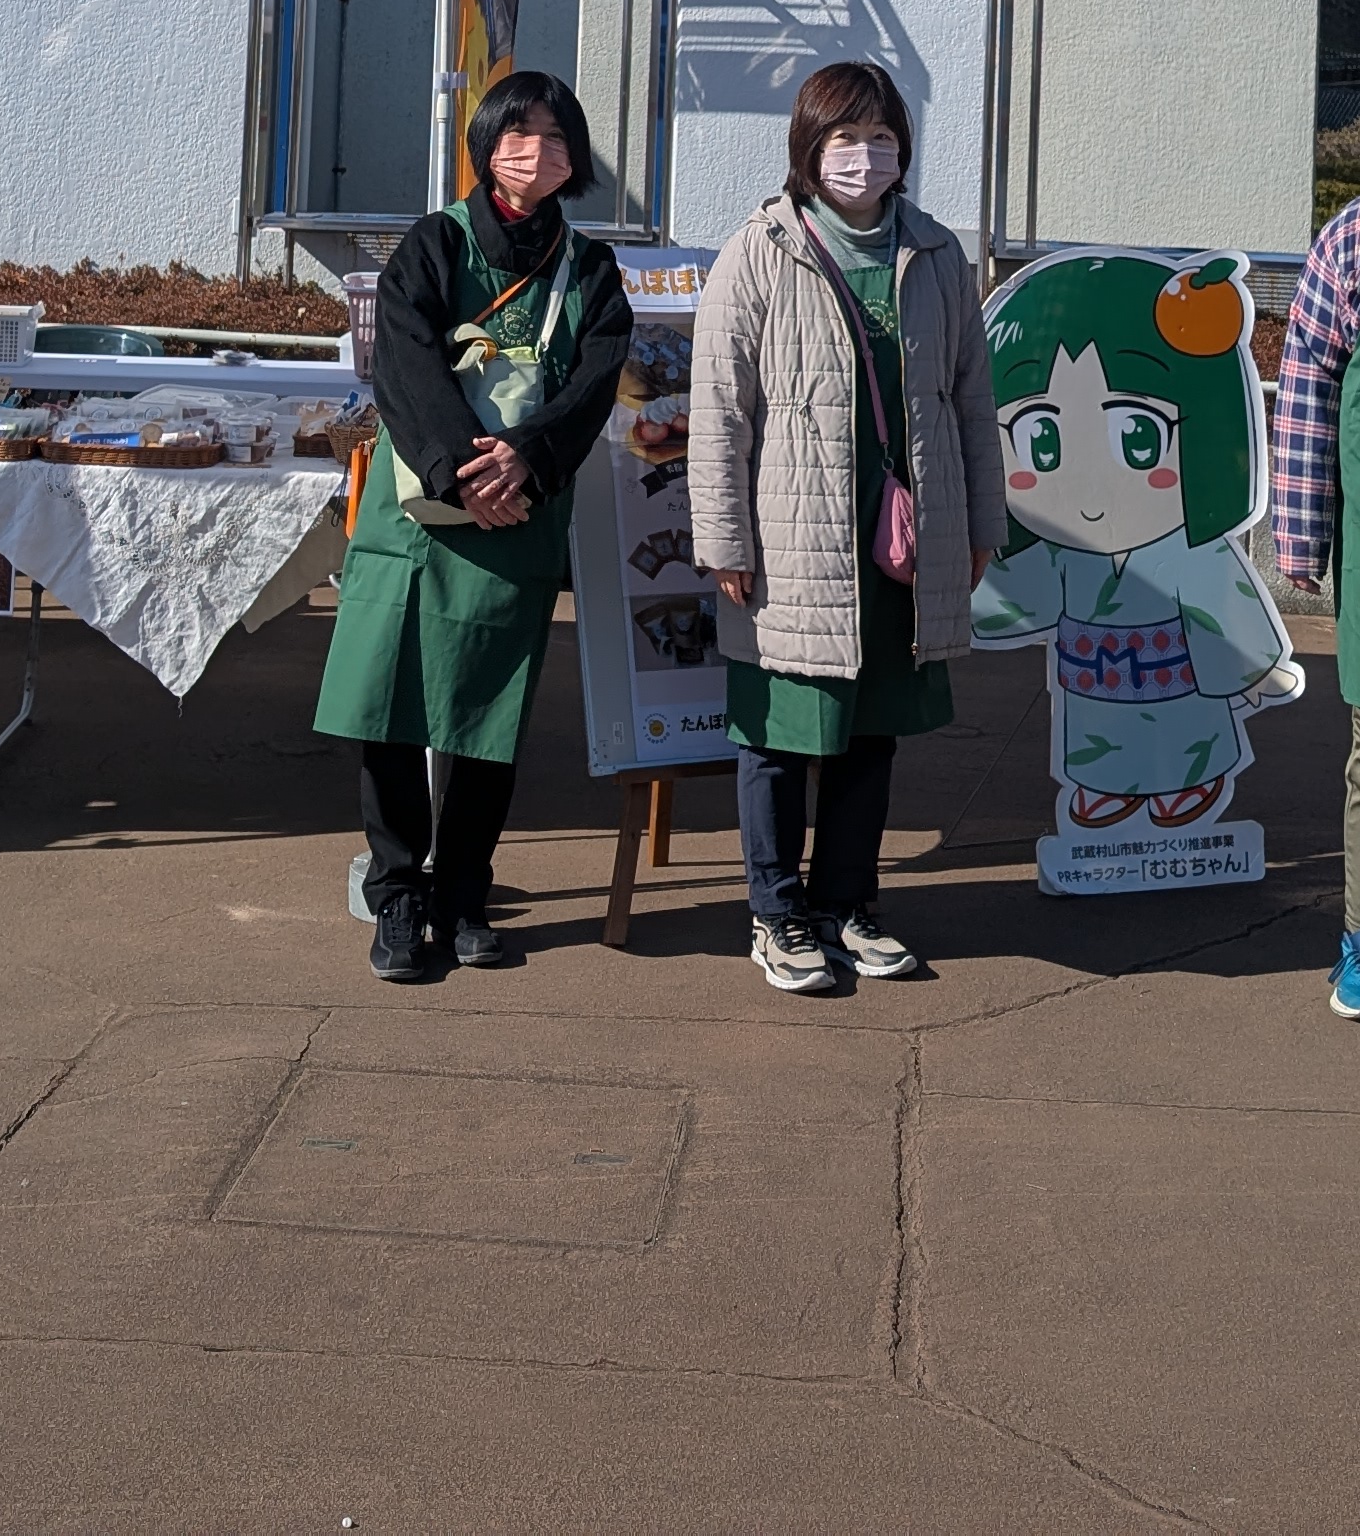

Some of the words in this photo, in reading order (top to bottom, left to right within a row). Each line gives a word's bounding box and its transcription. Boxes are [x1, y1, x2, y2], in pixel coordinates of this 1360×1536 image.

[621, 267, 699, 296] んぽぽ
[864, 321, 895, 339] ANPOPO
[667, 501, 688, 512] たん
[681, 713, 726, 732] たんぽ
[1071, 834, 1235, 860] 武蔵村山市魅力づくり推進事業
[1057, 851, 1250, 883] PRキャラクター「むむちゃん」
